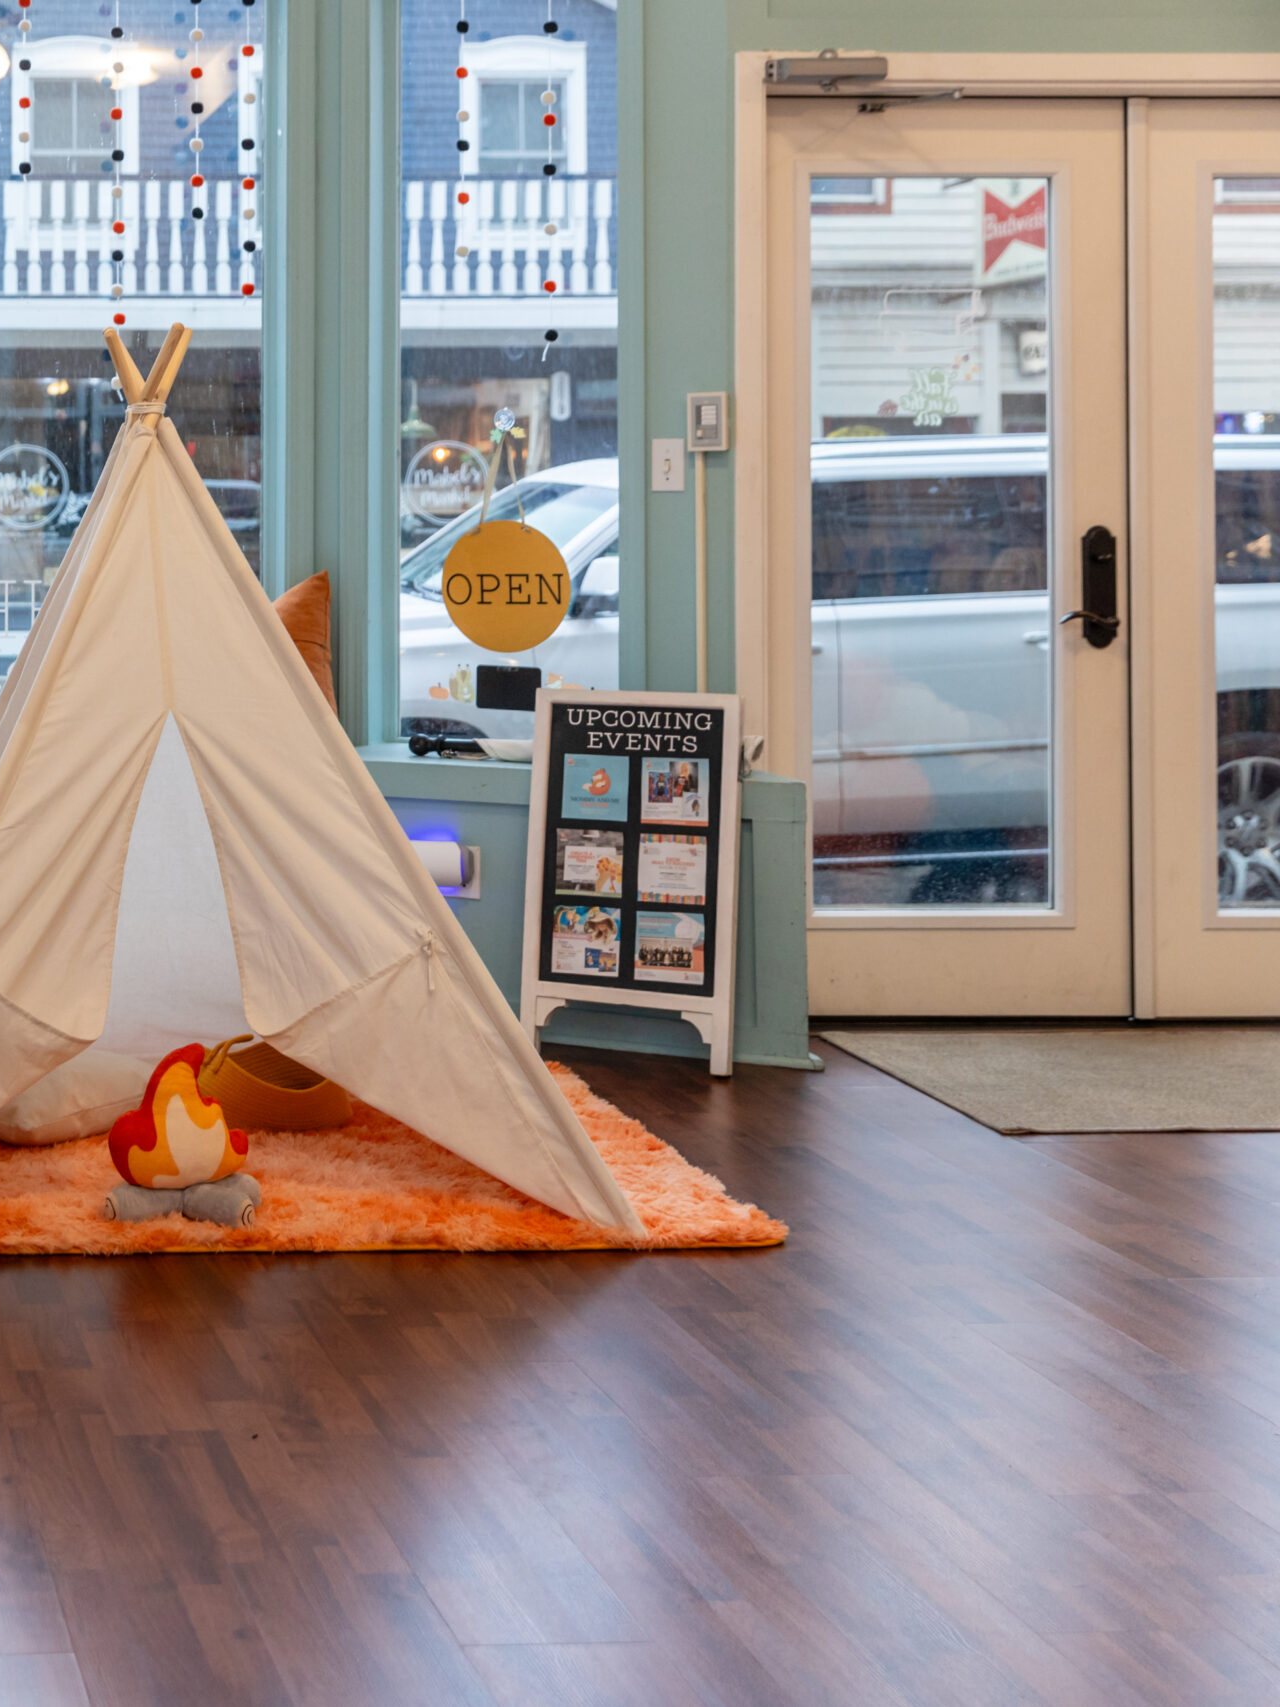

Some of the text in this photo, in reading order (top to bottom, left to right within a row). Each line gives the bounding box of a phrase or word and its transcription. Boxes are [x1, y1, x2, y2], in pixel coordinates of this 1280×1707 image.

[446, 573, 564, 605] OPEN
[567, 708, 713, 731] UPCOMING
[587, 731, 698, 753] EVENTS
